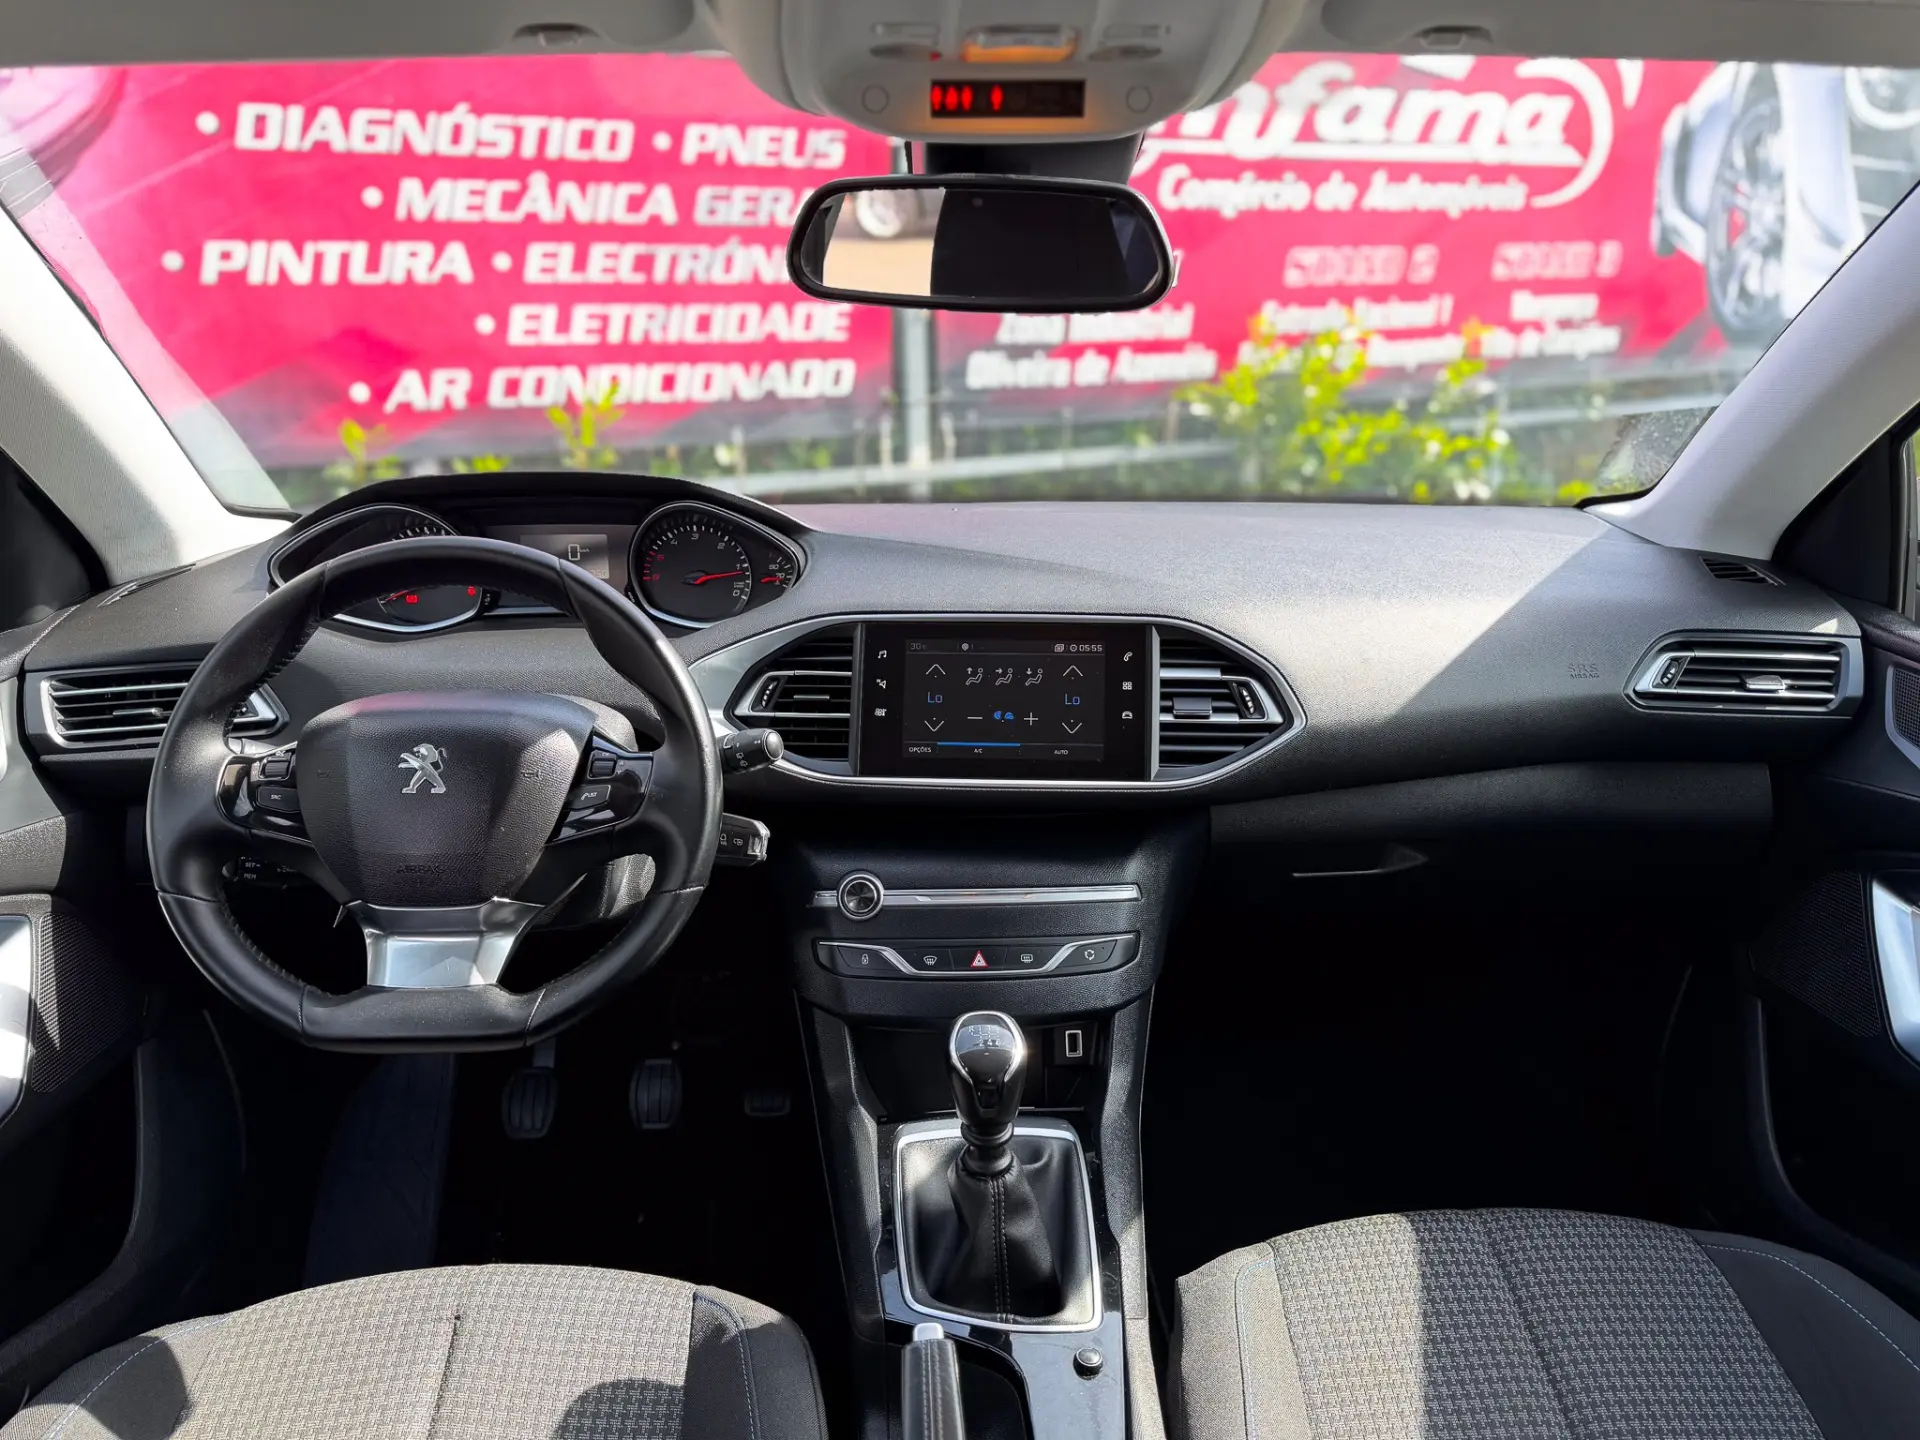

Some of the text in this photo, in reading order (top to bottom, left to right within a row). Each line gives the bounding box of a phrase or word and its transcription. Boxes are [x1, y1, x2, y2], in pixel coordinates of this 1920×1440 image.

[234, 102, 848, 169] DIAGNÓSTICO PNEUS
[395, 170, 679, 227] MECÂNICA
[199, 236, 792, 286] PINTURA ELECTRÓN
[506, 302, 853, 346] ELETRICIDADE
[383, 358, 857, 414] AR CONDICIONADO
